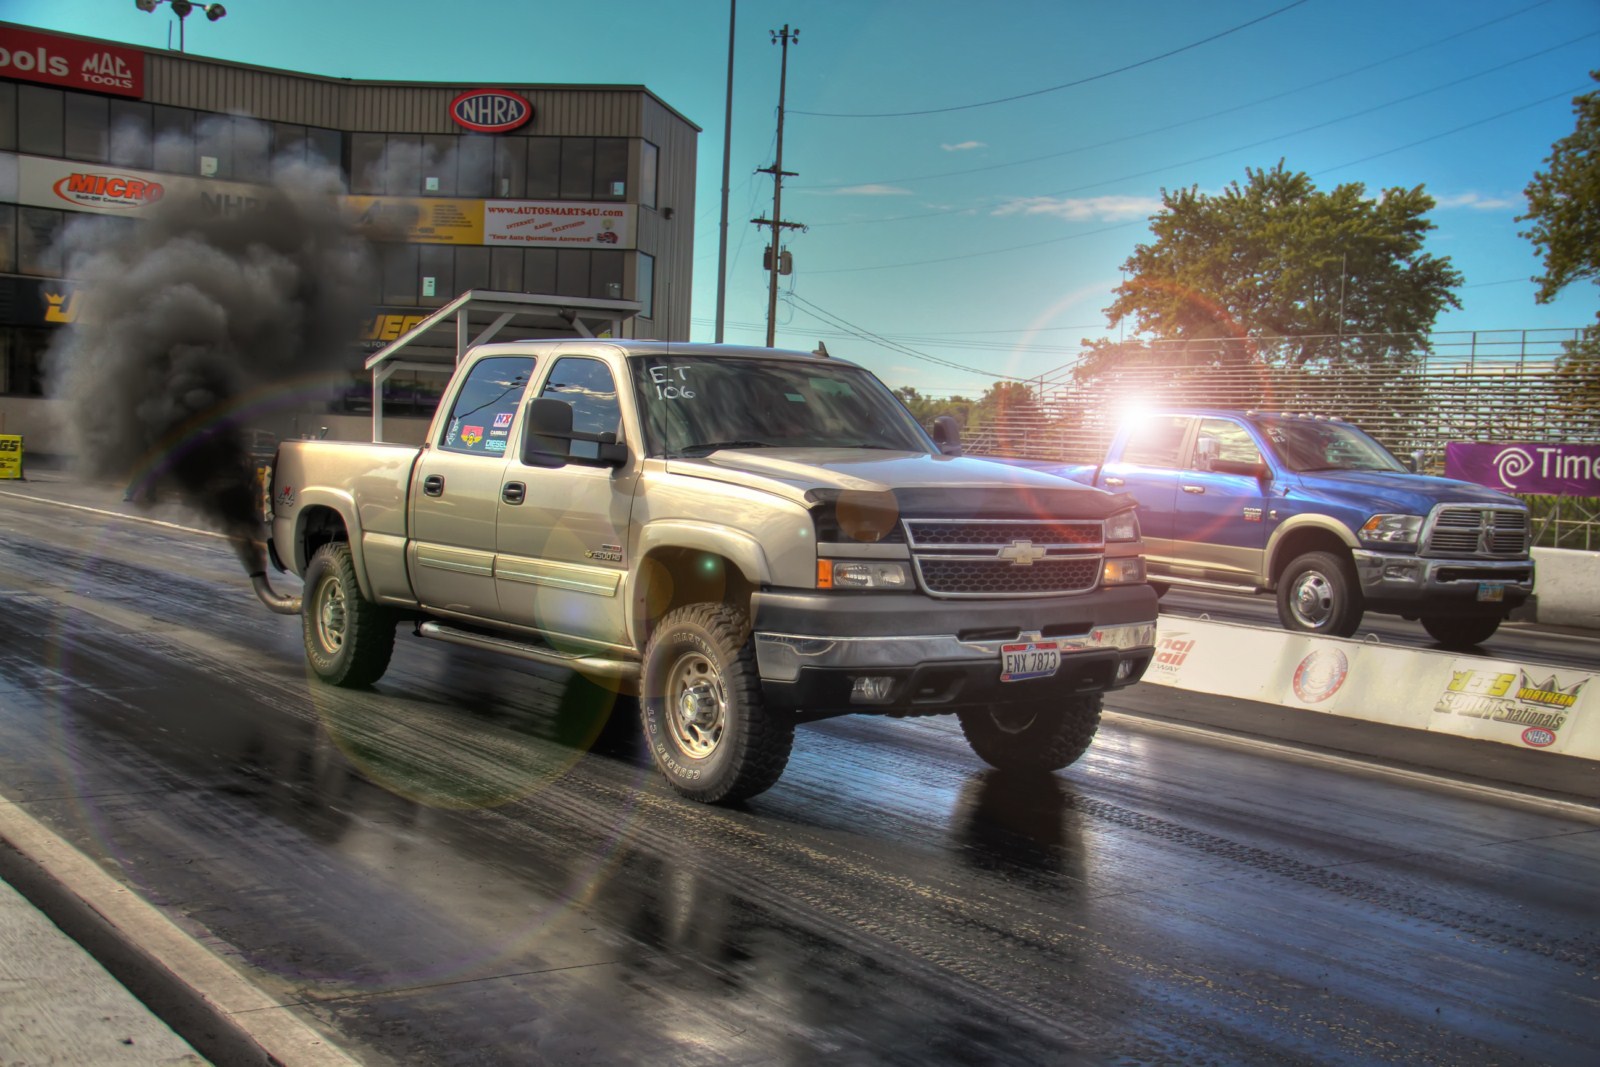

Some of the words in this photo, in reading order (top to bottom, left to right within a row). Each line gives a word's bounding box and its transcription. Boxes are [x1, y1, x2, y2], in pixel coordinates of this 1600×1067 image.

[82, 52, 132, 79] MAC
[81, 73, 133, 89] TOOLS
[463, 96, 518, 124] NHRA
[67, 173, 164, 203] MICRO
[488, 206, 623, 217] www.AUTOSMARTS4U.com
[506, 218, 535, 230] INTERNET
[534, 221, 553, 231] RADIO
[361, 314, 429, 341] JEG
[656, 385, 697, 400] 106
[1006, 653, 1027, 674] ENX
[1031, 651, 1057, 672] 7873
[1154, 652, 1187, 666] ail
[1516, 687, 1578, 707] NORTHERN
[1527, 730, 1551, 744] NHRA
